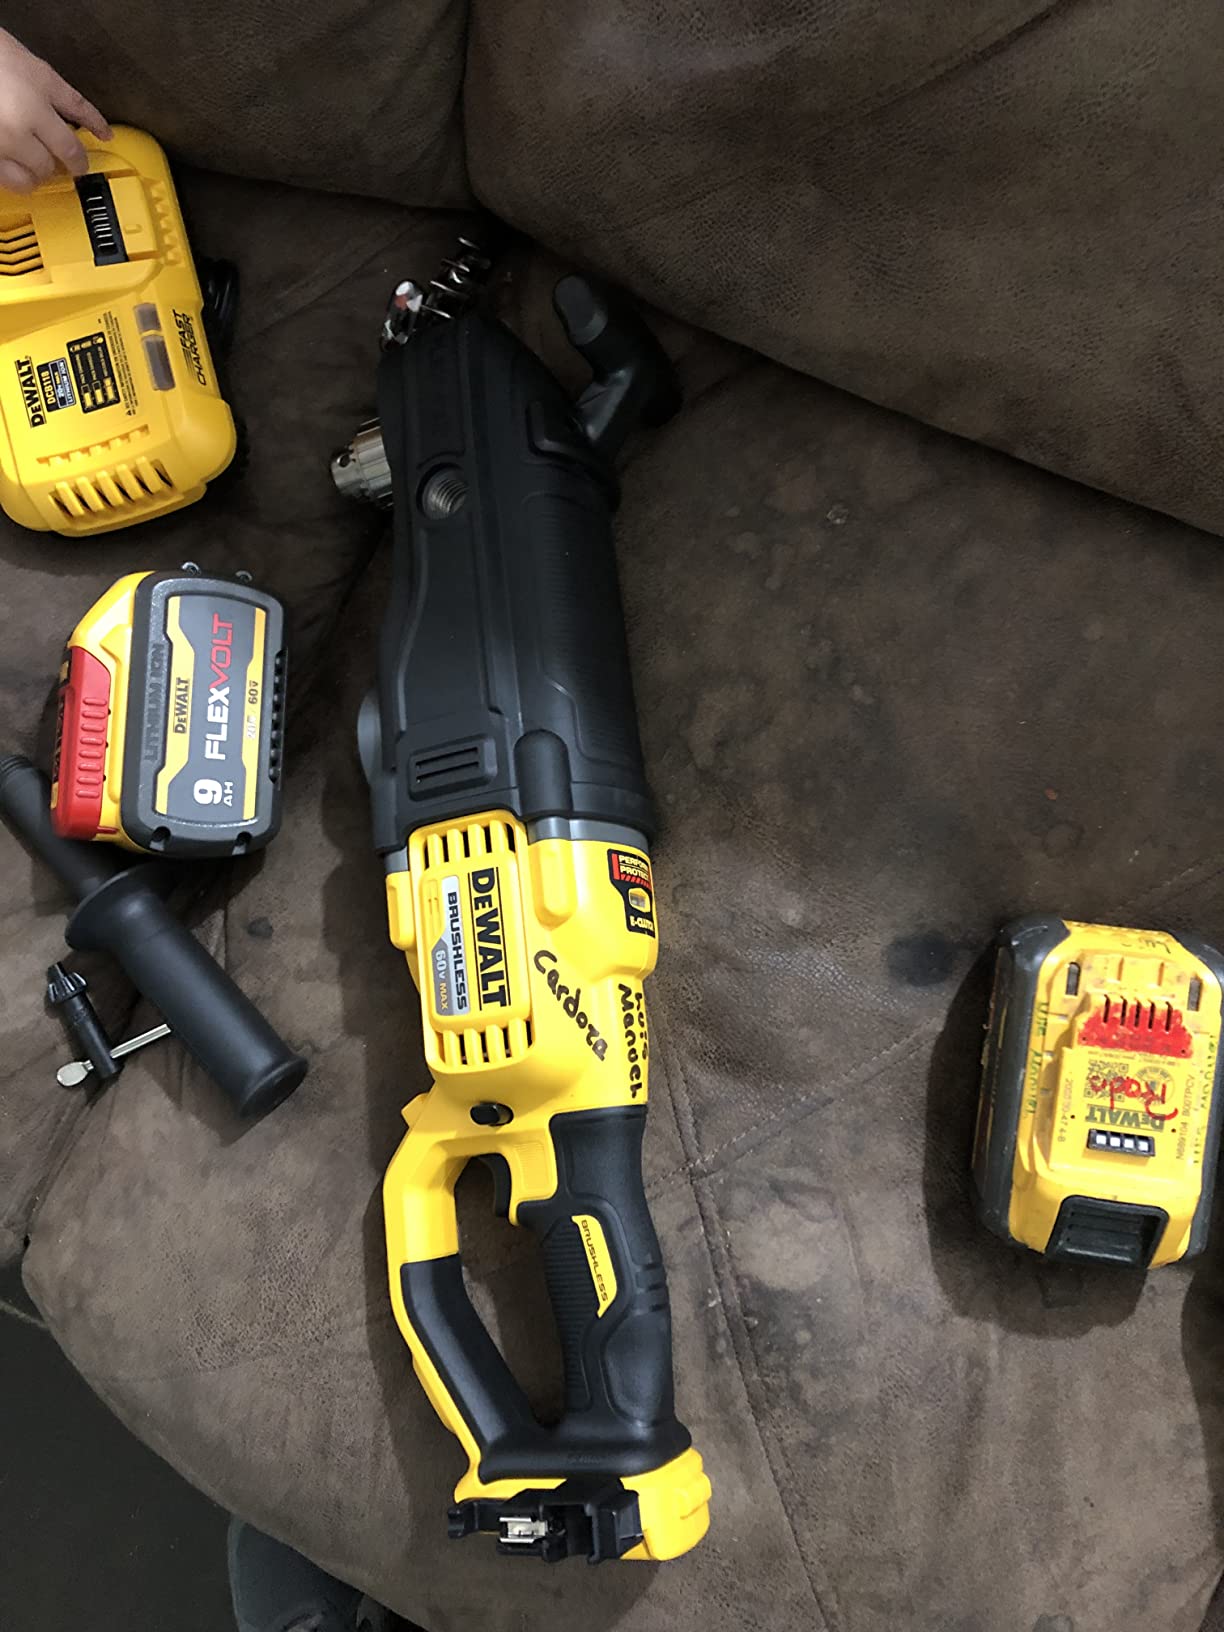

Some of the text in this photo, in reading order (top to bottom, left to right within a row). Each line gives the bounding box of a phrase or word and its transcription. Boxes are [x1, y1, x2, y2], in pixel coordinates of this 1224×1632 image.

[171, 308, 190, 349] FAST
[183, 313, 207, 386] CHARGER
[15, 356, 46, 428] DEWALT
[41, 371, 56, 405] DCB118
[205, 612, 234, 760] FLEXVOLT
[193, 778, 223, 805] 9
[223, 781, 234, 807] AH
[447, 891, 469, 1011] BRUSHLESS
[470, 867, 508, 1009] DEWALT
[438, 981, 449, 1010] MAX
[581, 1219, 608, 1302] BRUSHLESS
